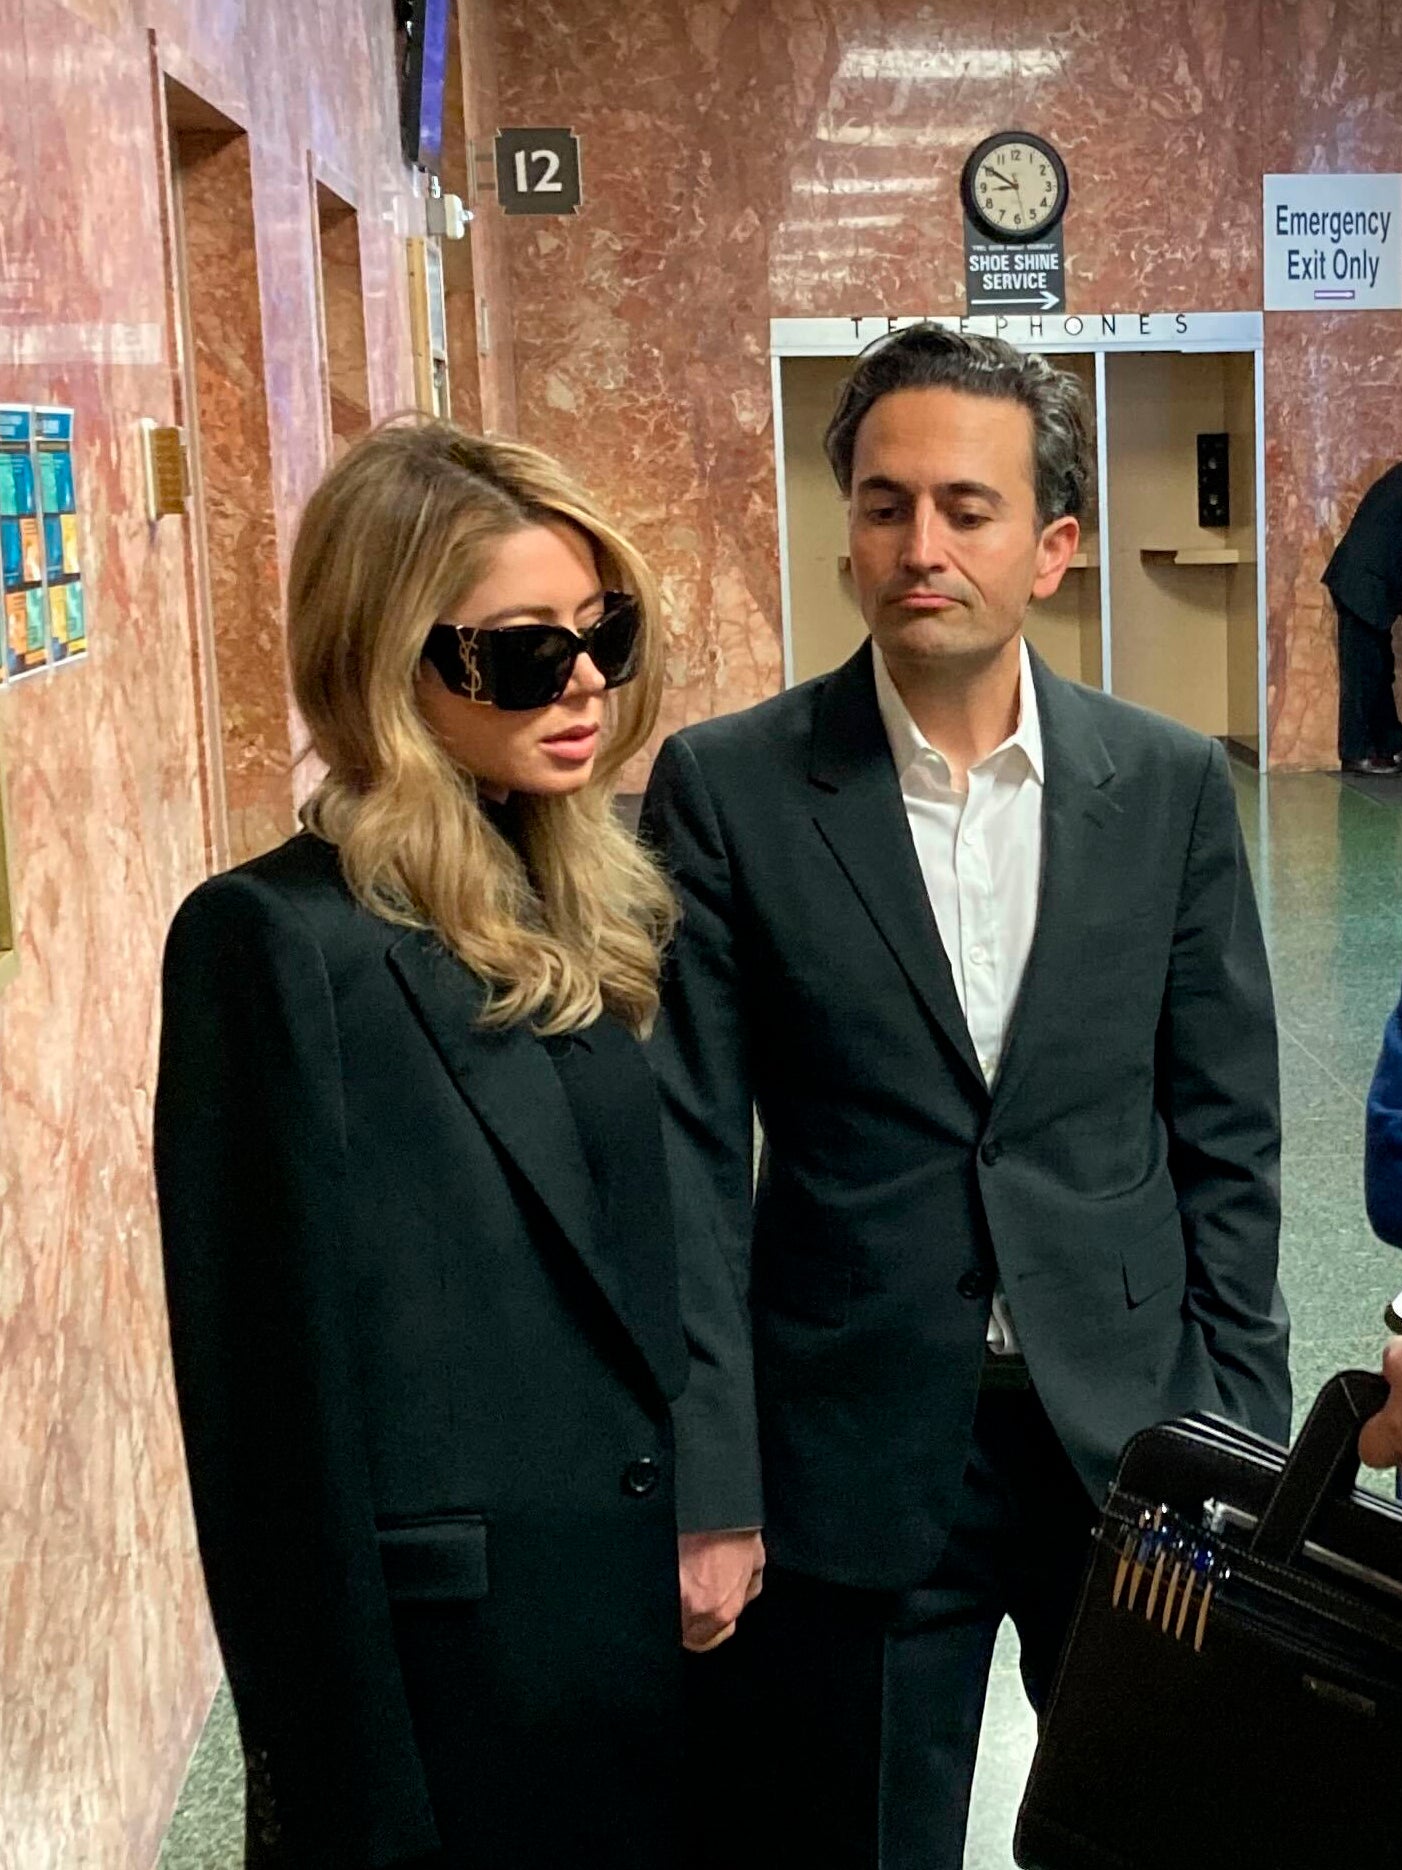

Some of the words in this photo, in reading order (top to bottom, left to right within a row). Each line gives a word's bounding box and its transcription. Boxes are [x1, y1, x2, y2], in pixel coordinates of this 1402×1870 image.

[515, 150, 562, 192] 12
[1276, 204, 1392, 244] Emergency
[968, 254, 1010, 272] SHOE
[1014, 253, 1059, 271] SHINE
[1287, 248, 1326, 280] Exit
[1333, 248, 1380, 288] Only
[982, 272, 1047, 290] SERVICE
[851, 313, 1188, 339] TEEPHONES
